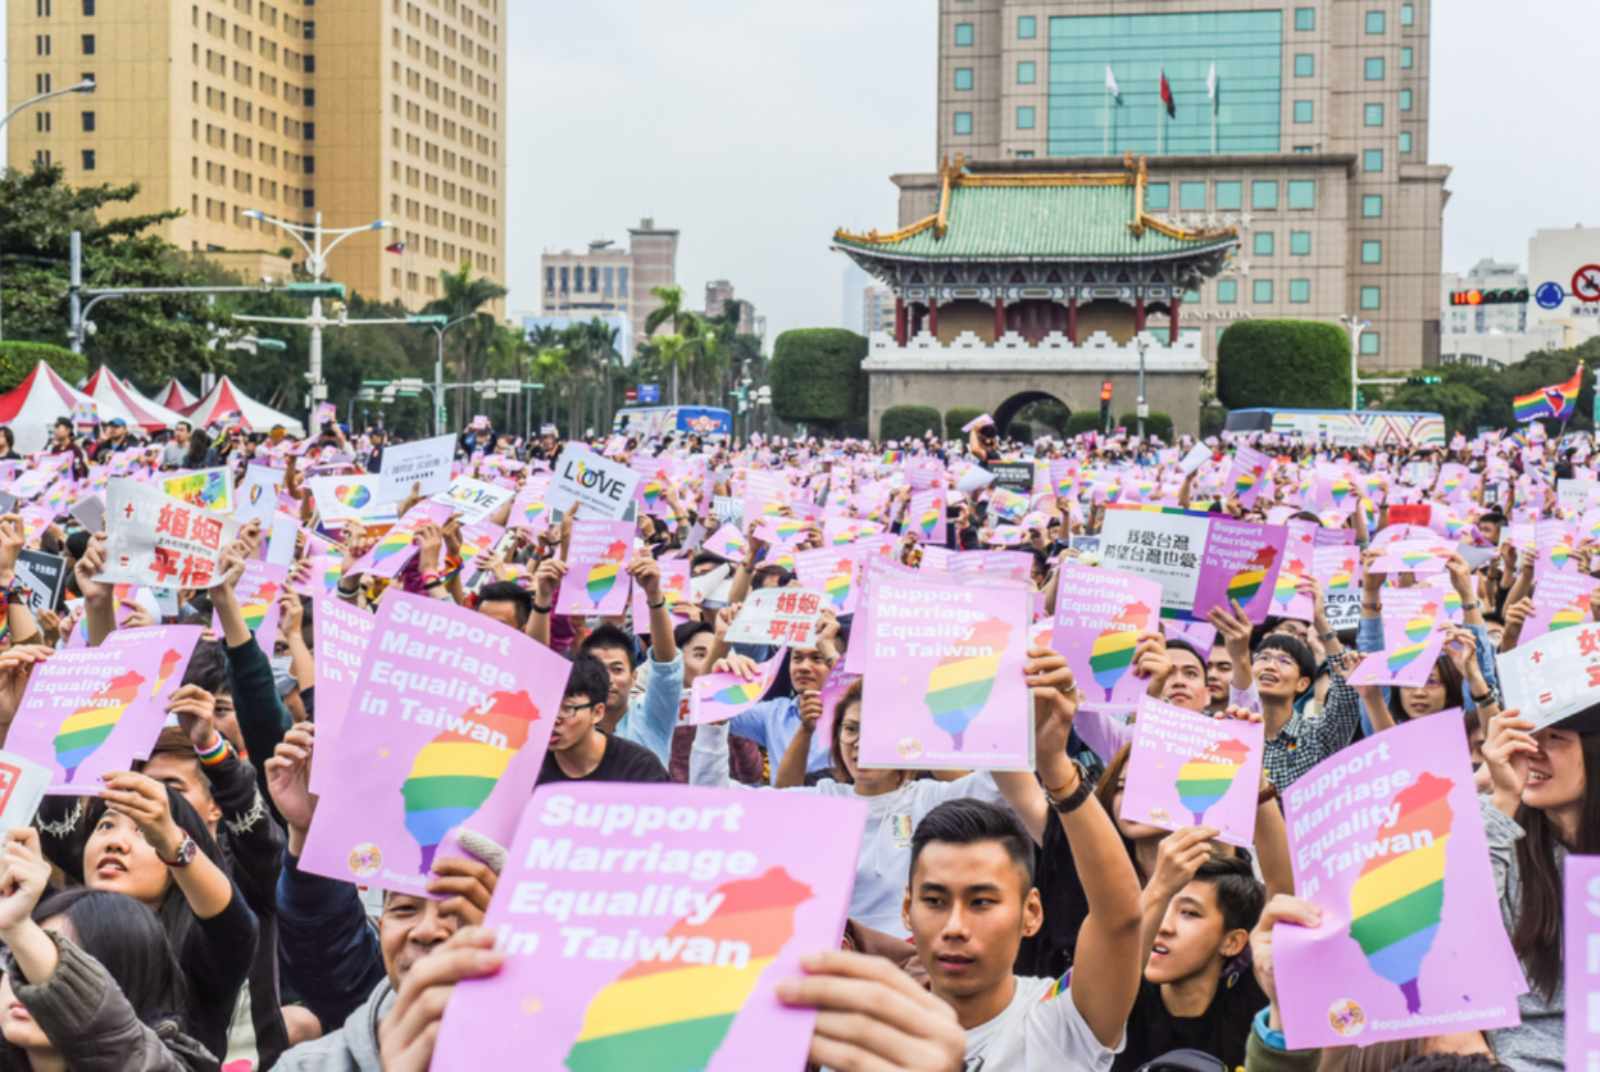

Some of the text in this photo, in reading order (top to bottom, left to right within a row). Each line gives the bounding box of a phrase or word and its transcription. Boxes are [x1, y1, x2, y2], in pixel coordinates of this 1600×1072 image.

[1127, 528, 1190, 551] 我愛台灣
[1104, 544, 1202, 569] 希望台灣也愛
[879, 585, 973, 603] Support
[321, 601, 374, 631] Supp
[879, 604, 986, 623] Marriage
[1324, 605, 1361, 618] GA
[321, 621, 370, 648] Marr
[390, 600, 513, 657] Support
[877, 624, 976, 641] Equality
[53, 650, 122, 662] Support
[380, 629, 517, 689] Marriage
[875, 642, 993, 657] in Taiwan
[39, 664, 128, 677] Marriage
[32, 680, 112, 694] Equality
[370, 660, 497, 714] Equality
[52, 696, 121, 709] Taiwan
[1145, 700, 1221, 724] Support
[360, 690, 510, 751] in Taiwan
[1143, 711, 1231, 738] Marriage
[1141, 721, 1220, 752] Equality
[1165, 741, 1232, 766] Taiwan
[1289, 741, 1391, 812] Support
[539, 794, 745, 837] Support
[1294, 769, 1411, 841] Marriage
[1298, 802, 1401, 872] Equality
[524, 837, 759, 881] Marriage
[1302, 829, 1435, 901] in Taiwan
[508, 880, 726, 926] Equality
[559, 925, 751, 971] Taiwan
